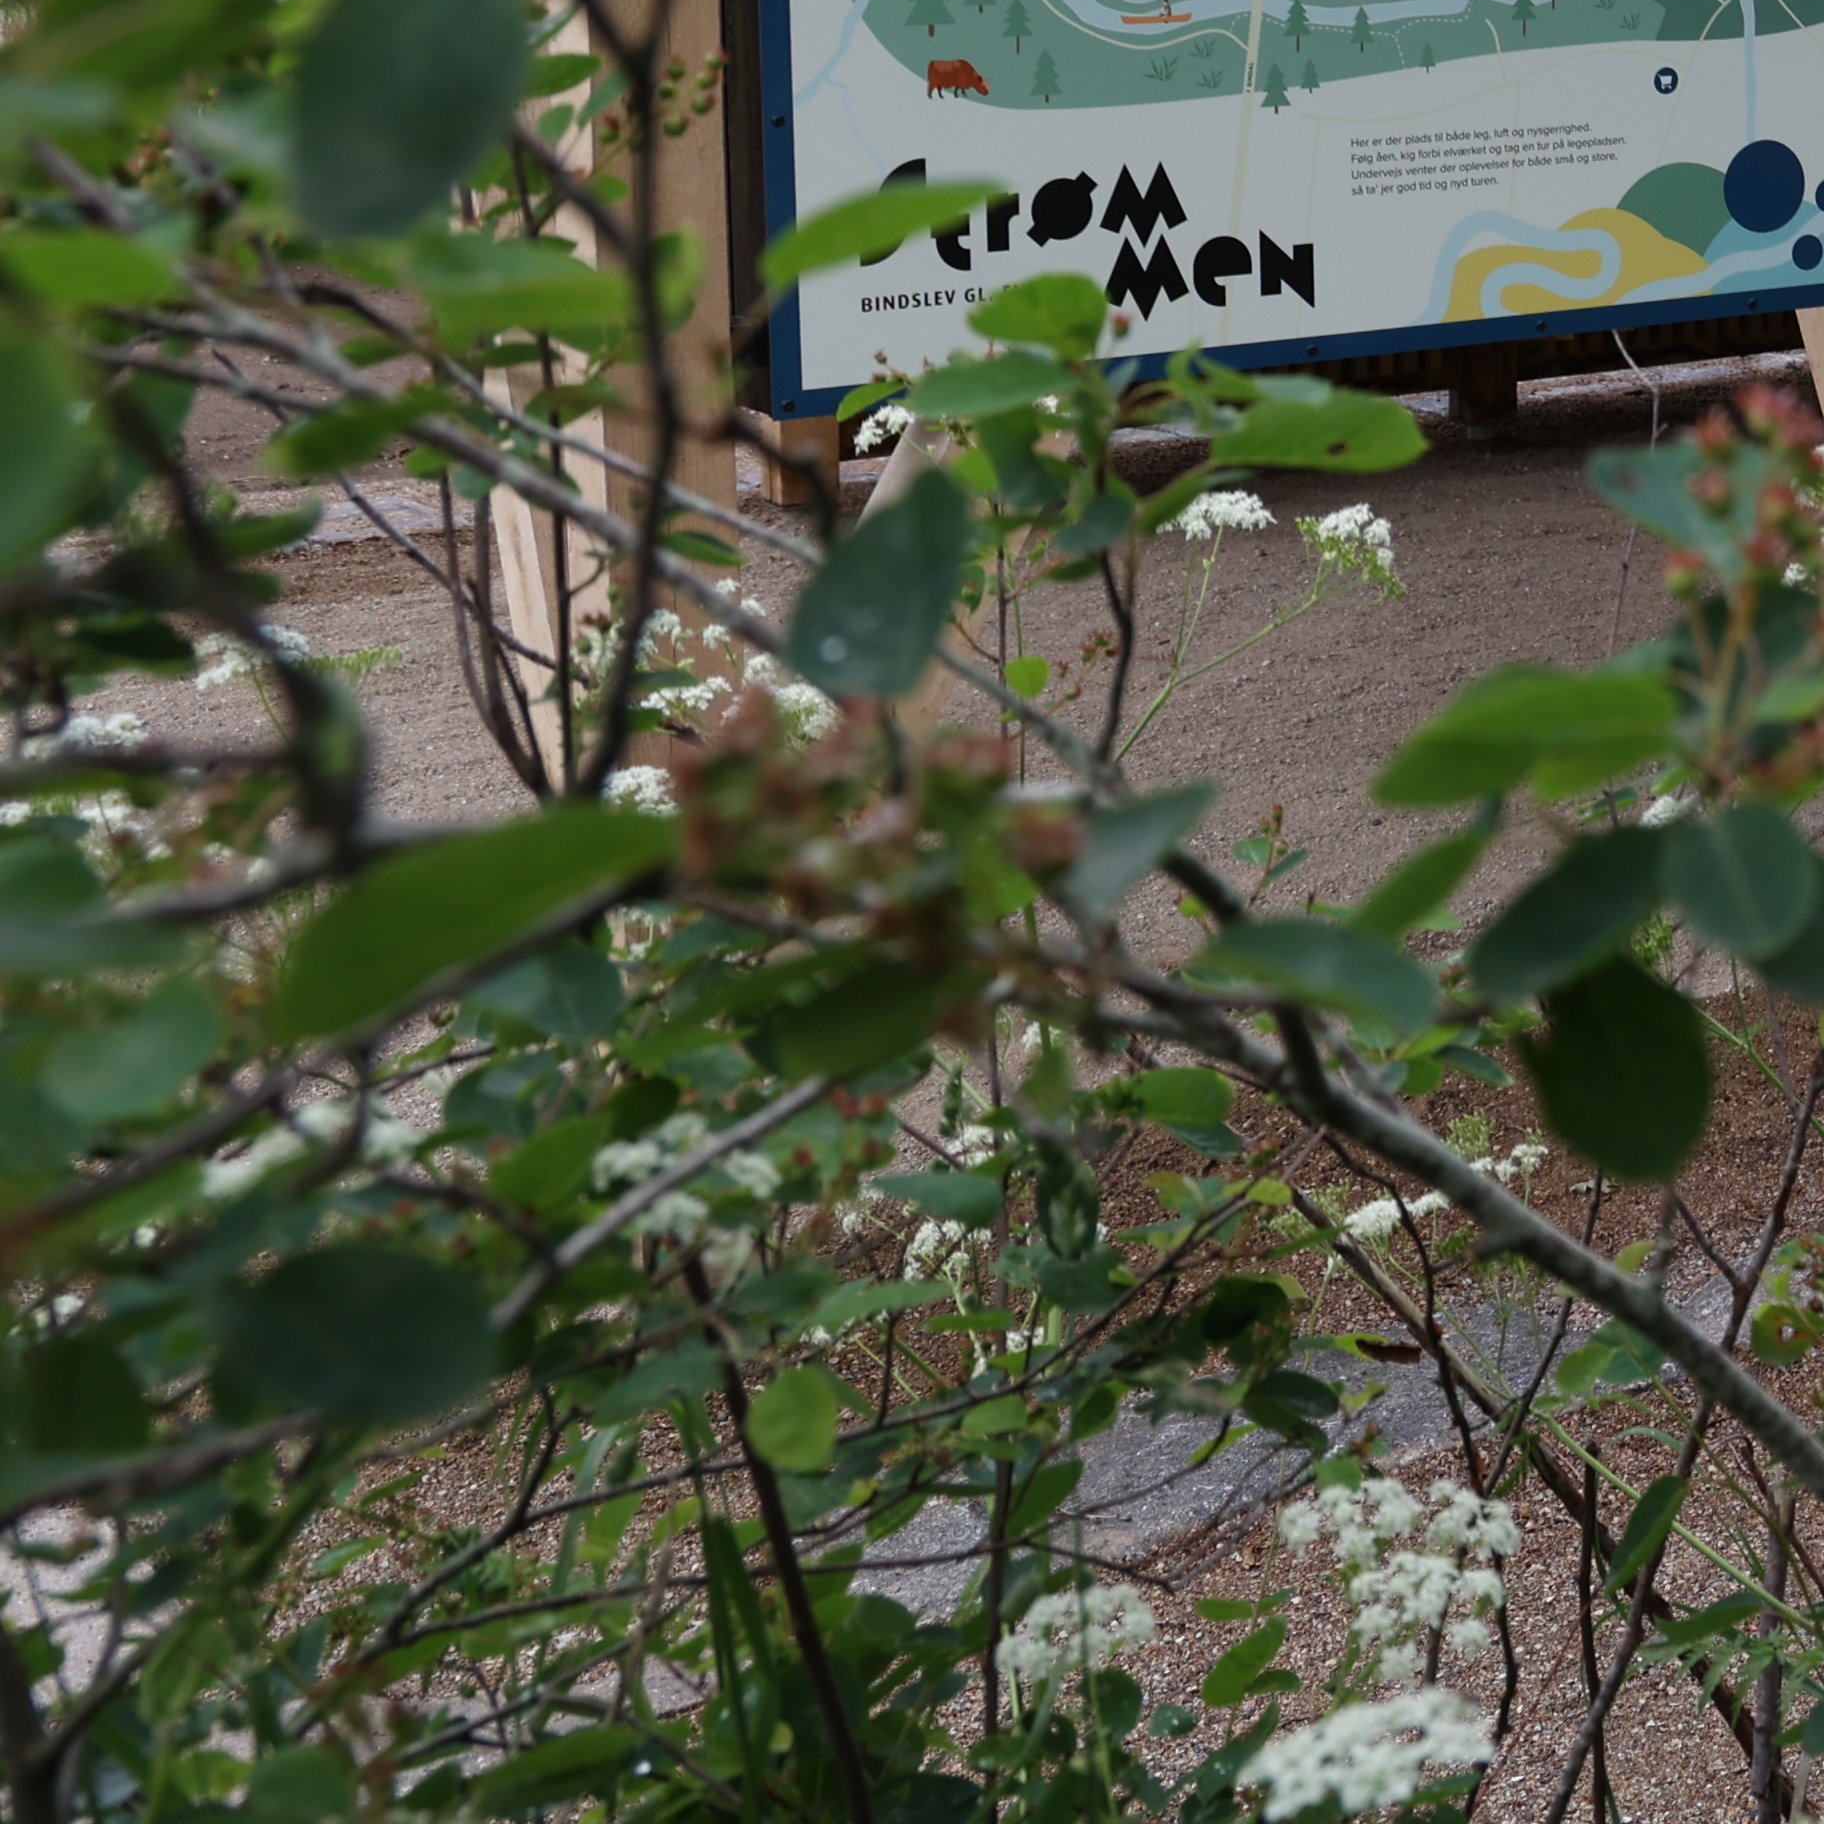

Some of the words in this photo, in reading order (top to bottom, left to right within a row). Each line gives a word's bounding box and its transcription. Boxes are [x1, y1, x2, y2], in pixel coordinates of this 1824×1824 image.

[1350, 137, 1369, 149] Her
[1372, 138, 1383, 147] er
[1385, 134, 1403, 146] der
[1405, 133, 1432, 147] plads
[1434, 132, 1444, 143] til
[1446, 129, 1471, 142] både
[1473, 129, 1492, 142] leg,
[1494, 128, 1510, 138] luft
[1511, 128, 1525, 139] og
[1527, 123, 1592, 137] nysgerrighed.
[1351, 153, 1373, 167] Følg
[1376, 151, 1398, 163] åen,
[1400, 149, 1416, 163] kig
[1418, 146, 1441, 159] forbi
[1443, 145, 1487, 158] elværket
[1489, 145, 1502, 156] og
[1504, 143, 1520, 155] tag
[1522, 143, 1535, 152] en
[1537, 141, 1551, 151] tur
[1552, 139, 1565, 151] på
[1567, 134, 1627, 150] legepladsen.
[1351, 168, 1403, 180] Undervejs
[1405, 166, 1437, 175] venter
[1439, 163, 1457, 174] der
[1459, 159, 1510, 173] oplevelser
[1512, 158, 1525, 168] for
[1528, 155, 1552, 167] både
[1555, 153, 1575, 165] små
[1577, 153, 1590, 164] og
[1592, 151, 1618, 163] store,
[1352, 184, 1364, 196] så
[1366, 184, 1379, 195] ta'
[1380, 183, 1394, 196] jer
[1397, 180, 1417, 194] god
[1419, 179, 1432, 191] tid
[1434, 180, 1448, 191] og
[1450, 177, 1469, 190] nyd
[1470, 175, 1499, 187] turen.
[861, 289, 956, 313] BINDSLEV
